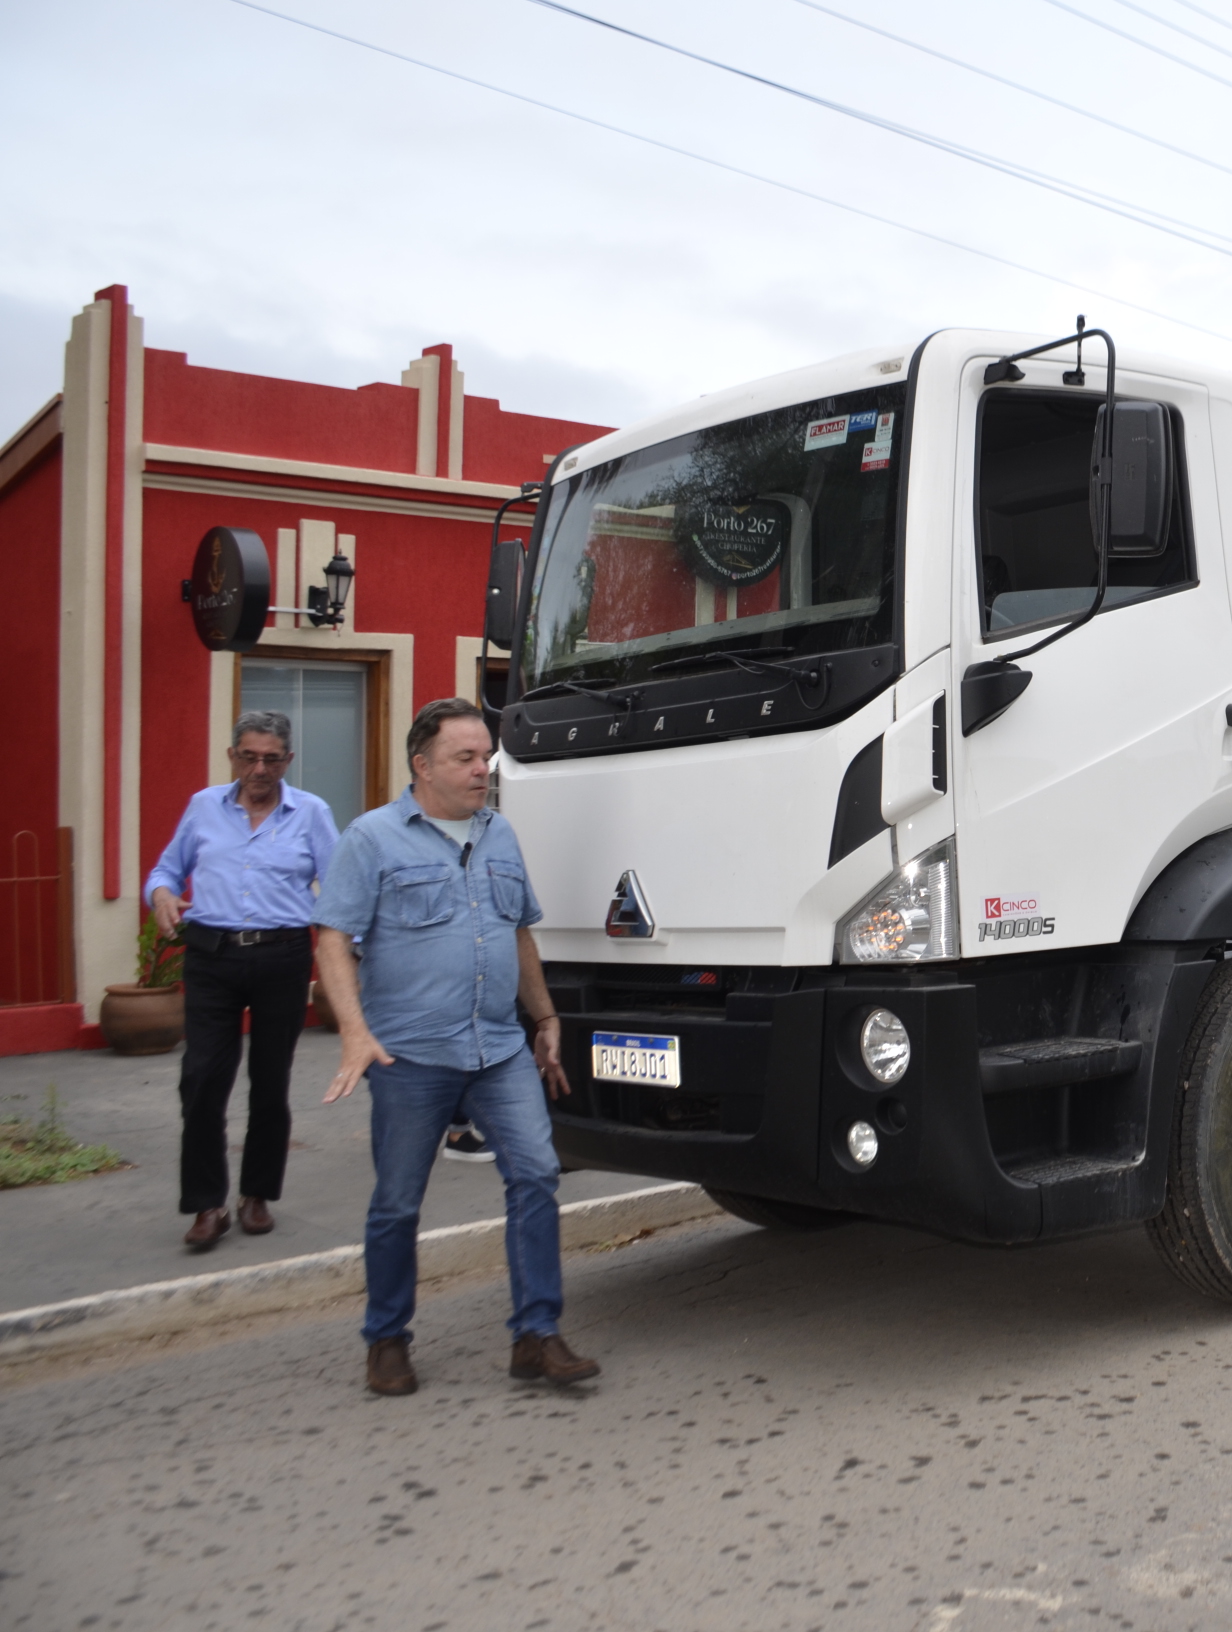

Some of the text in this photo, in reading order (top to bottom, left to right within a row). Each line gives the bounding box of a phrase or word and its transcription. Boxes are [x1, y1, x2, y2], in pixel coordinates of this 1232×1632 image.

[811, 421, 845, 437] FLAMAR
[703, 512, 776, 535] Porto 267
[530, 700, 774, 745] AGRALE
[1001, 899, 1037, 912] CINCO
[978, 917, 1055, 942] 14000S
